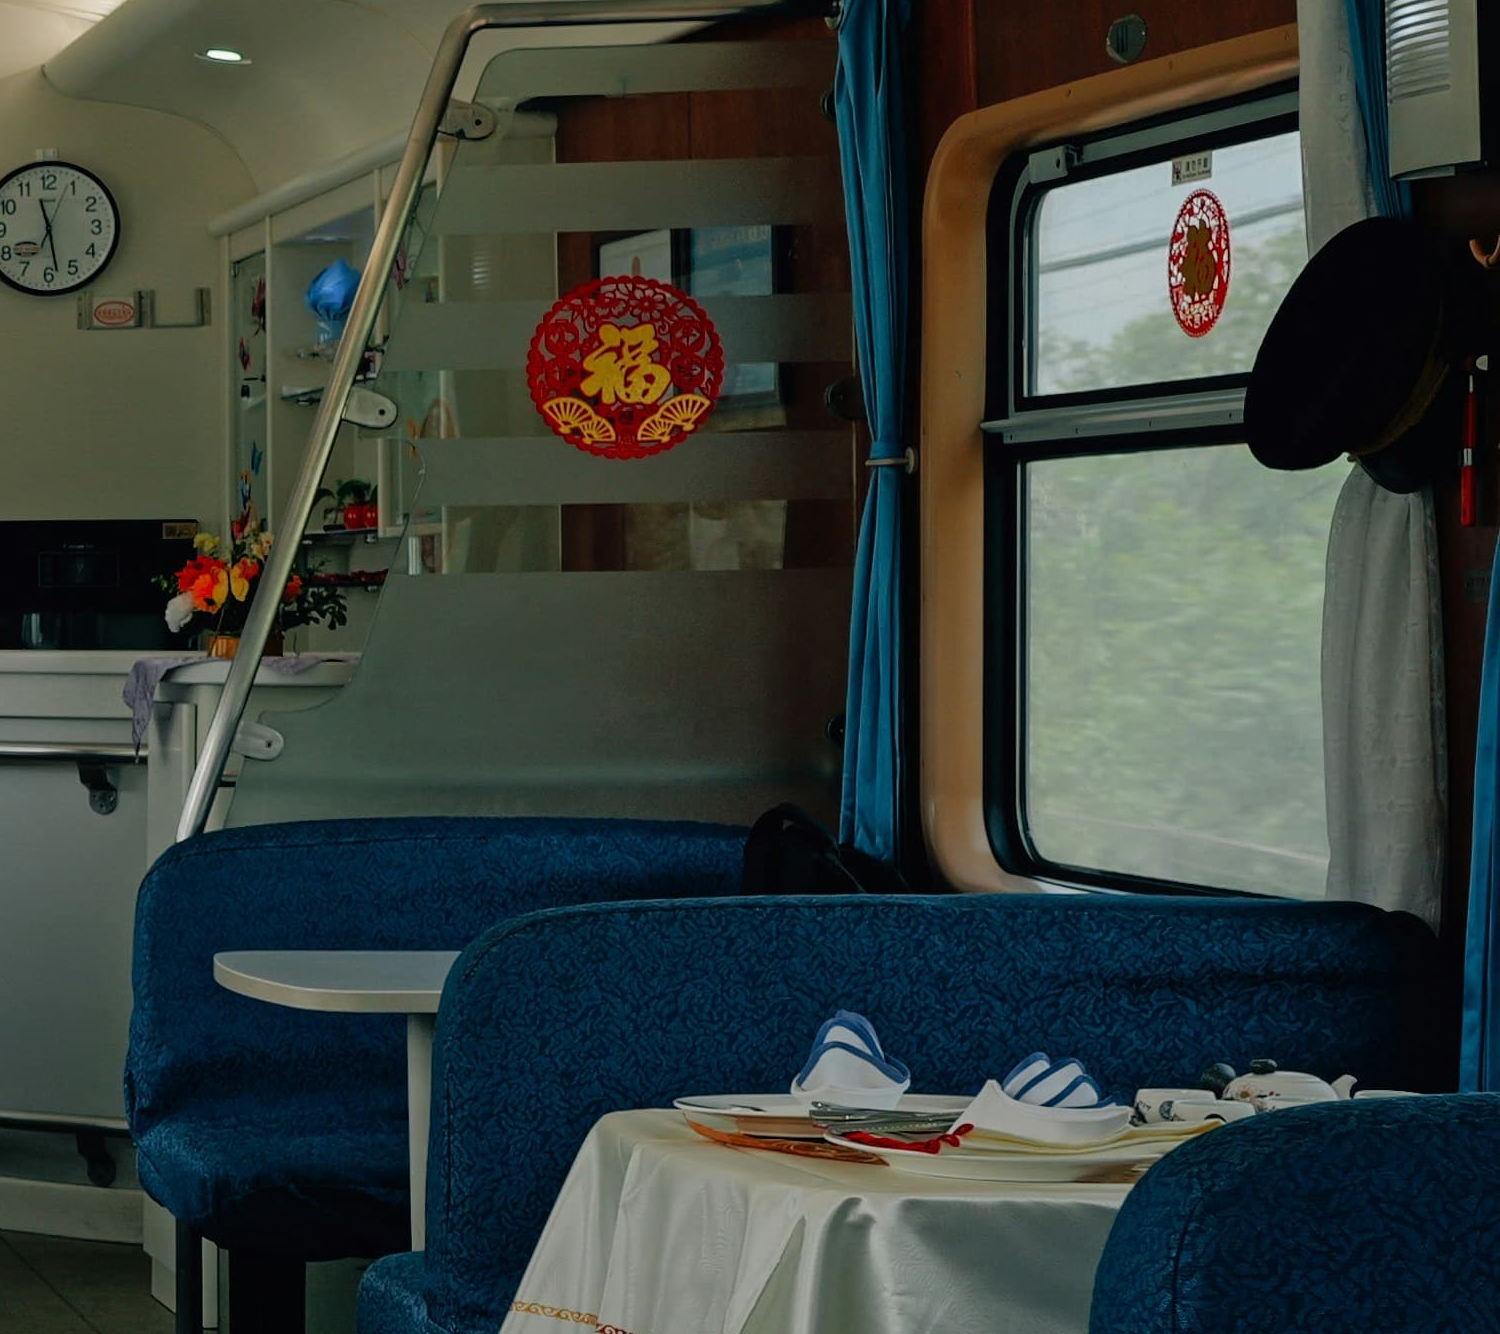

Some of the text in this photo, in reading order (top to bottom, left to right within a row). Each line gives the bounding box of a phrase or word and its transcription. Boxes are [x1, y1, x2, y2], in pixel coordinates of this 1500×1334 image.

[18, 181, 31, 196] 11
[41, 174, 57, 191] 12
[70, 180, 76, 195] 1
[1, 198, 16, 215] 10
[85, 196, 97, 212] 2
[91, 219, 102, 235] 3
[1, 245, 12, 261] 8
[85, 243, 95, 258] 4
[19, 261, 30, 276] 7
[43, 267, 54, 283] 6
[67, 260, 78, 275] 5
[580, 323, 672, 406] 福
